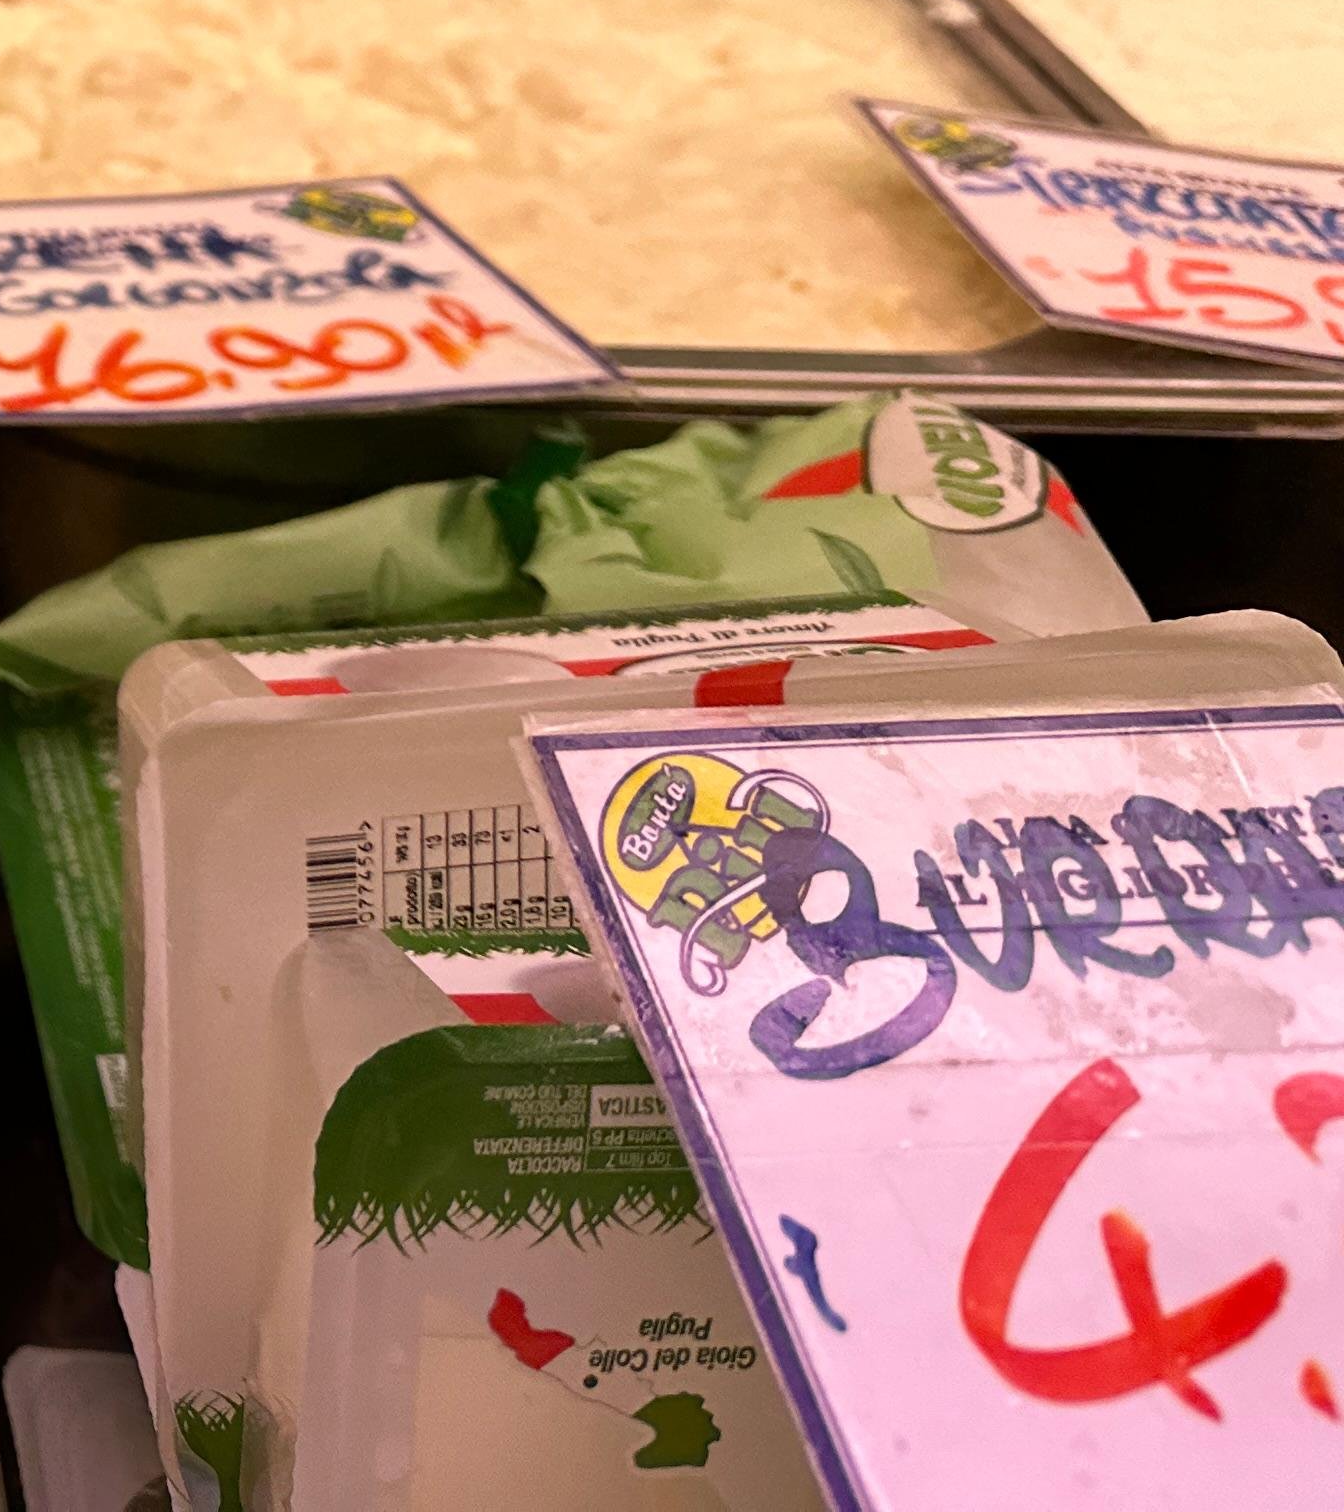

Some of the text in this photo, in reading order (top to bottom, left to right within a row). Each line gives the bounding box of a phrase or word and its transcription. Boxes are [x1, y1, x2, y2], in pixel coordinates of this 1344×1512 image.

[507, 1156, 582, 1175] RACCOLTA
[638, 1311, 714, 1342] Puglia
[587, 1345, 757, 1373] Gioia del Colle
